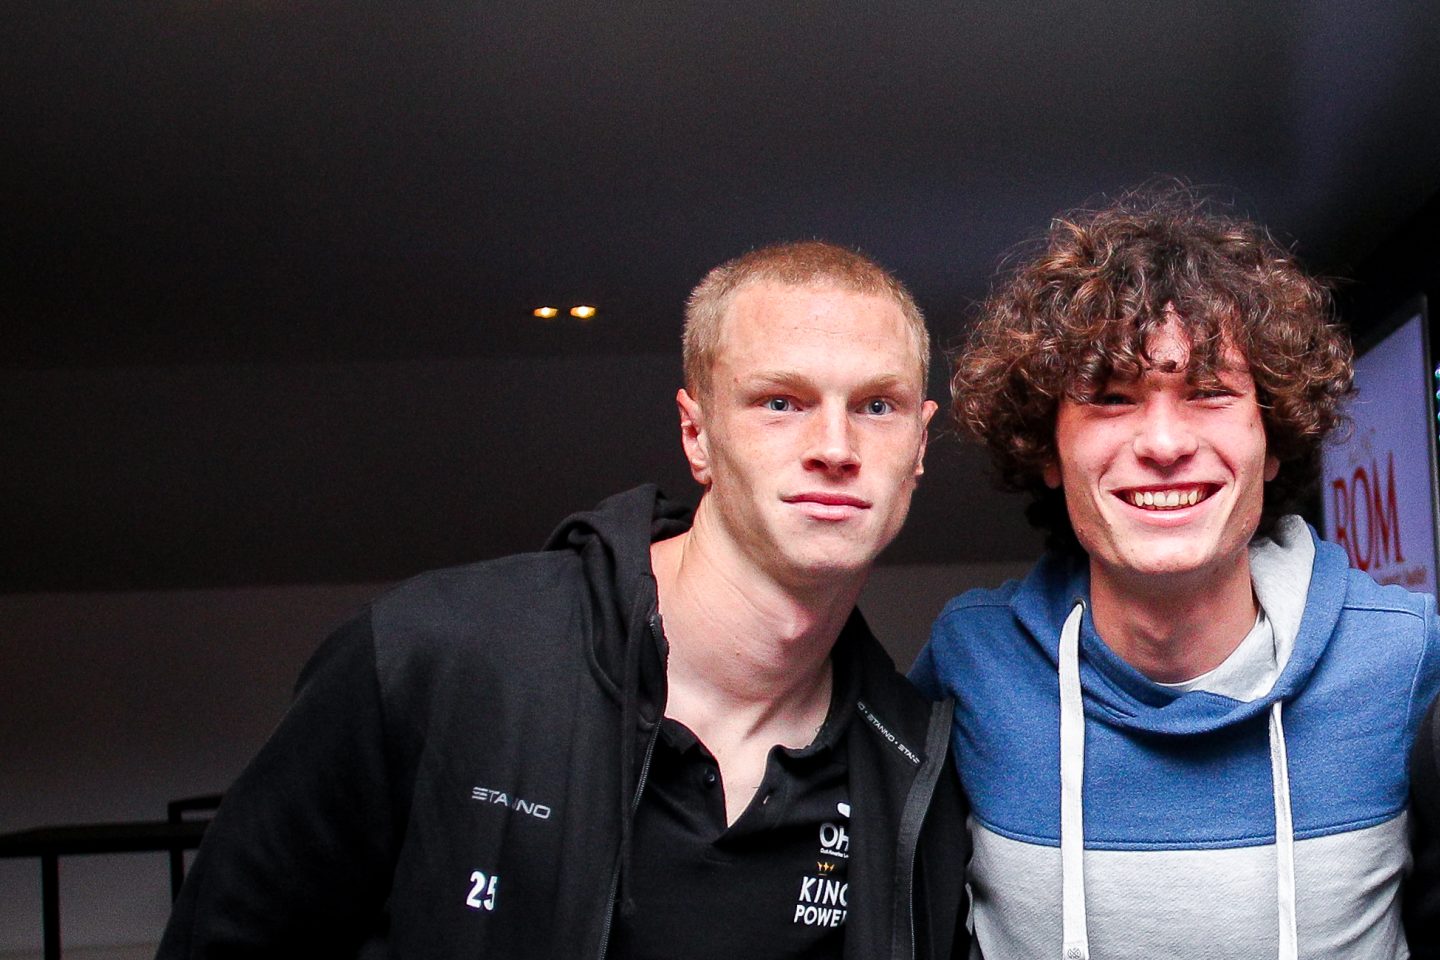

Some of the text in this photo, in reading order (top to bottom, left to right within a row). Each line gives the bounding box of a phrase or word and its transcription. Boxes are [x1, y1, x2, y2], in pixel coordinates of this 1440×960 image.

[471, 786, 551, 819] STANO
[820, 822, 849, 852] OH
[466, 870, 498, 911] 25
[793, 904, 848, 928] POWE
